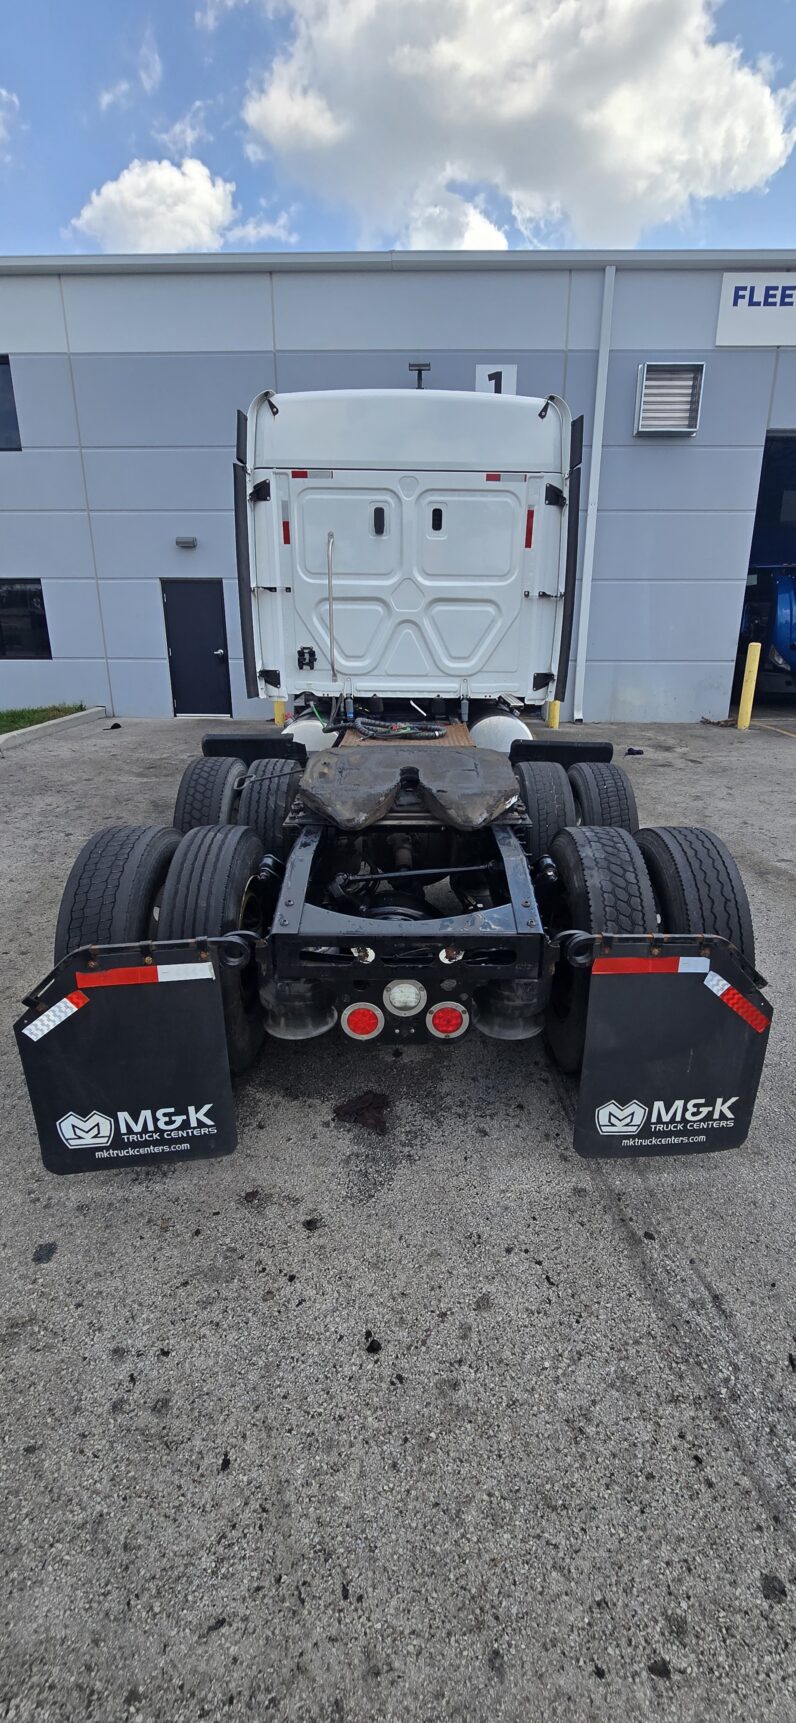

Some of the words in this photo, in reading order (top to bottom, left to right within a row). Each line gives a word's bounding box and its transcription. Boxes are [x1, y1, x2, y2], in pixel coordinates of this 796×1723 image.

[488, 371, 502, 394] 1
[650, 1096, 740, 1123] M&K
[117, 1103, 215, 1134] M&K
[650, 1122, 684, 1132] TRUCK
[687, 1119, 735, 1130] CENTERS
[122, 1132, 161, 1143] TRUCK
[164, 1126, 217, 1139] CENTERS
[621, 1135, 706, 1146] mktruckcenters.com
[95, 1143, 190, 1159] mktruckcenters.com
